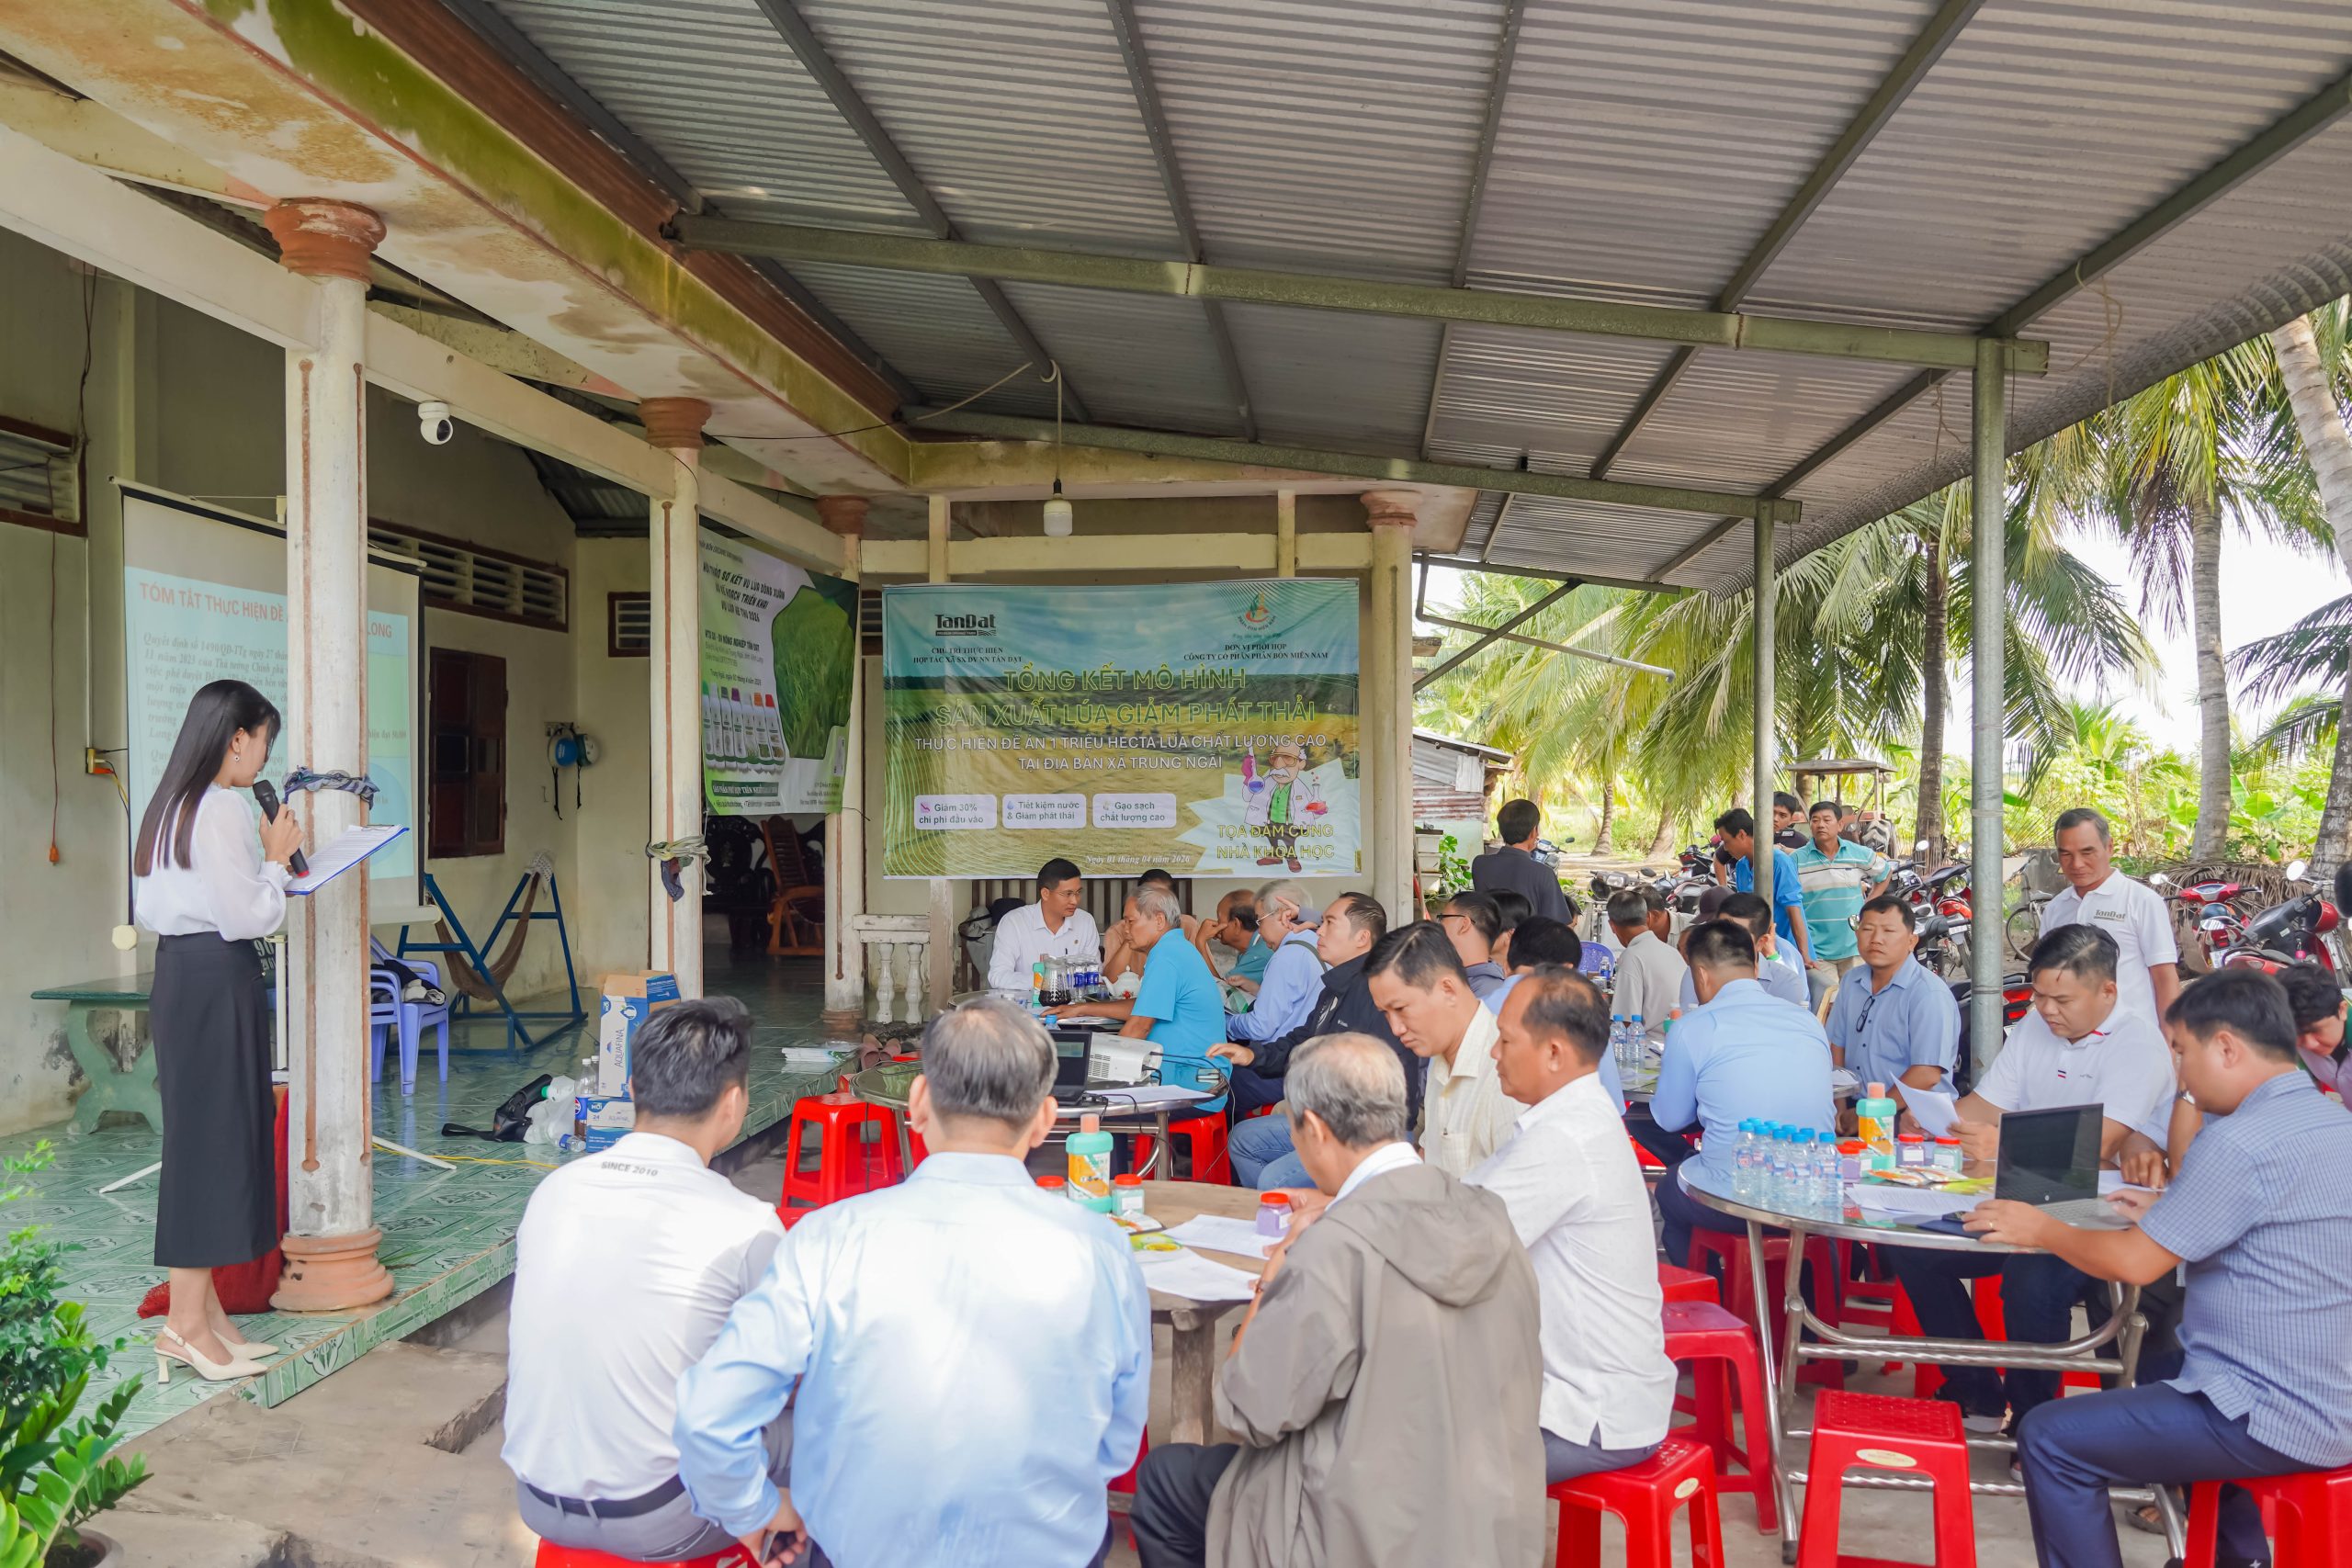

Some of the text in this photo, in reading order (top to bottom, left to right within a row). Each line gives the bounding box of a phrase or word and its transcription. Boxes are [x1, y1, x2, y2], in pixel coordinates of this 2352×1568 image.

[721, 570, 730, 581] SƠ
[730, 573, 742, 586] KẾT
[741, 592, 757, 606] TRIỂN
[140, 581, 392, 639] TÓM TẮT THỰC HIỆN ĐỀ ONG
[935, 615, 996, 628] TanDat
[1183, 651, 1205, 660] CÔNG
[1003, 660, 1246, 691] TỔNG KẾT MÔ HÌNH
[935, 694, 1315, 727] SẢN XUẤT LÚA GIẢM PHÁT THẢI
[915, 729, 1327, 752] THỰC HIỆN ĐỀ ÁN 1 TRIỆU HECTA LÚA CHẤT LƯỢNG CAO
[1018, 753, 1222, 772] TẠI ĐỊA BÀN XÃ TRUNG NGÃI
[933, 803, 978, 812] Giảm 30%
[1018, 800, 1080, 810] Tiết kiệm nước
[1114, 801, 1155, 811] Gạo sạch
[919, 816, 932, 824] chi
[949, 814, 966, 824] đầu
[1015, 812, 1036, 820] Giảm
[1039, 811, 1057, 820] phát
[1100, 811, 1118, 821] chất
[1121, 814, 1148, 823] lượng
[1216, 825, 1248, 840] TỌA
[1216, 842, 1335, 861] NHÀ KHOA HỌC
[1087, 855, 1191, 864] Ngày 01 tháng 04 năm 2026
[2095, 909, 2126, 919] TanDat
[615, 1028, 625, 1068] AQUAFINA
[601, 1161, 659, 1177] SINCE 2010
